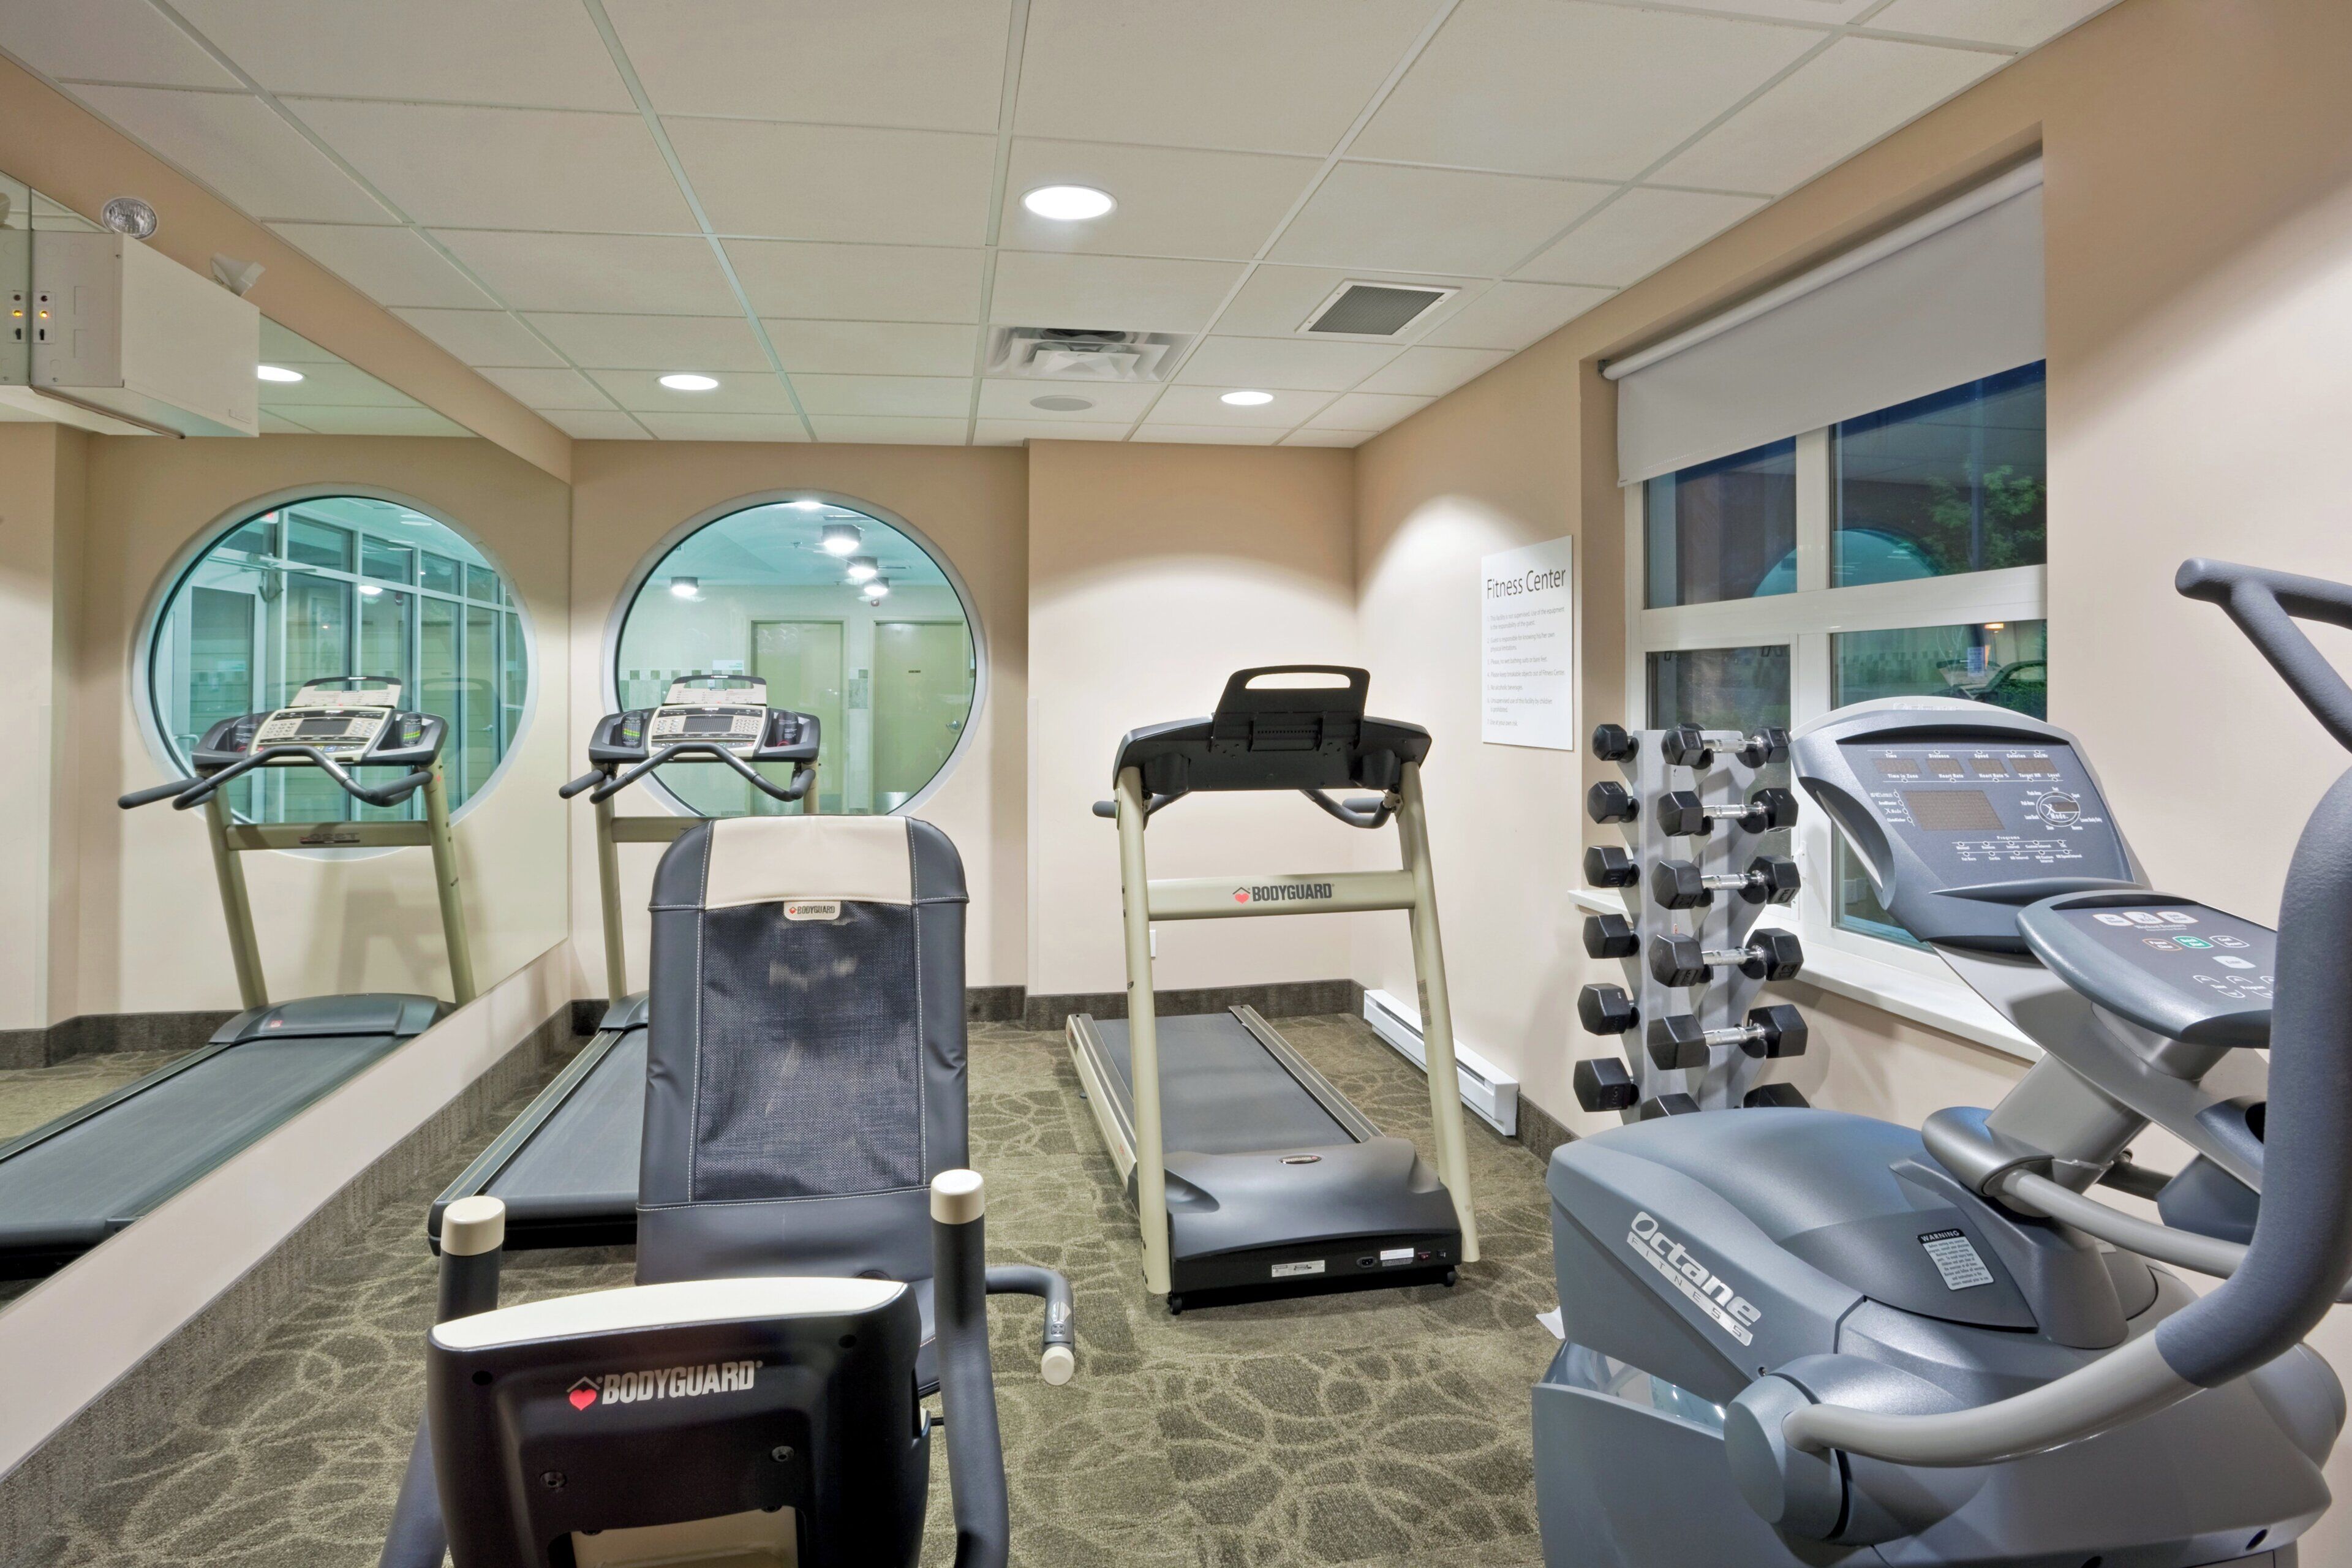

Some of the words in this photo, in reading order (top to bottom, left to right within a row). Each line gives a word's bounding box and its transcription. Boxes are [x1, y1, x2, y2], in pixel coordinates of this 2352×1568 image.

[1487, 578, 1523, 599] Fitness
[1526, 569, 1566, 592] Center
[1252, 883, 1333, 902] BODYGUARD
[797, 906, 835, 914] BODYGUARD
[1921, 1230, 1960, 1242] WARNING
[1631, 1211, 1762, 1327] Octane
[1630, 1236, 1743, 1338] FITNESS
[601, 1360, 755, 1405] BODYGUARD
